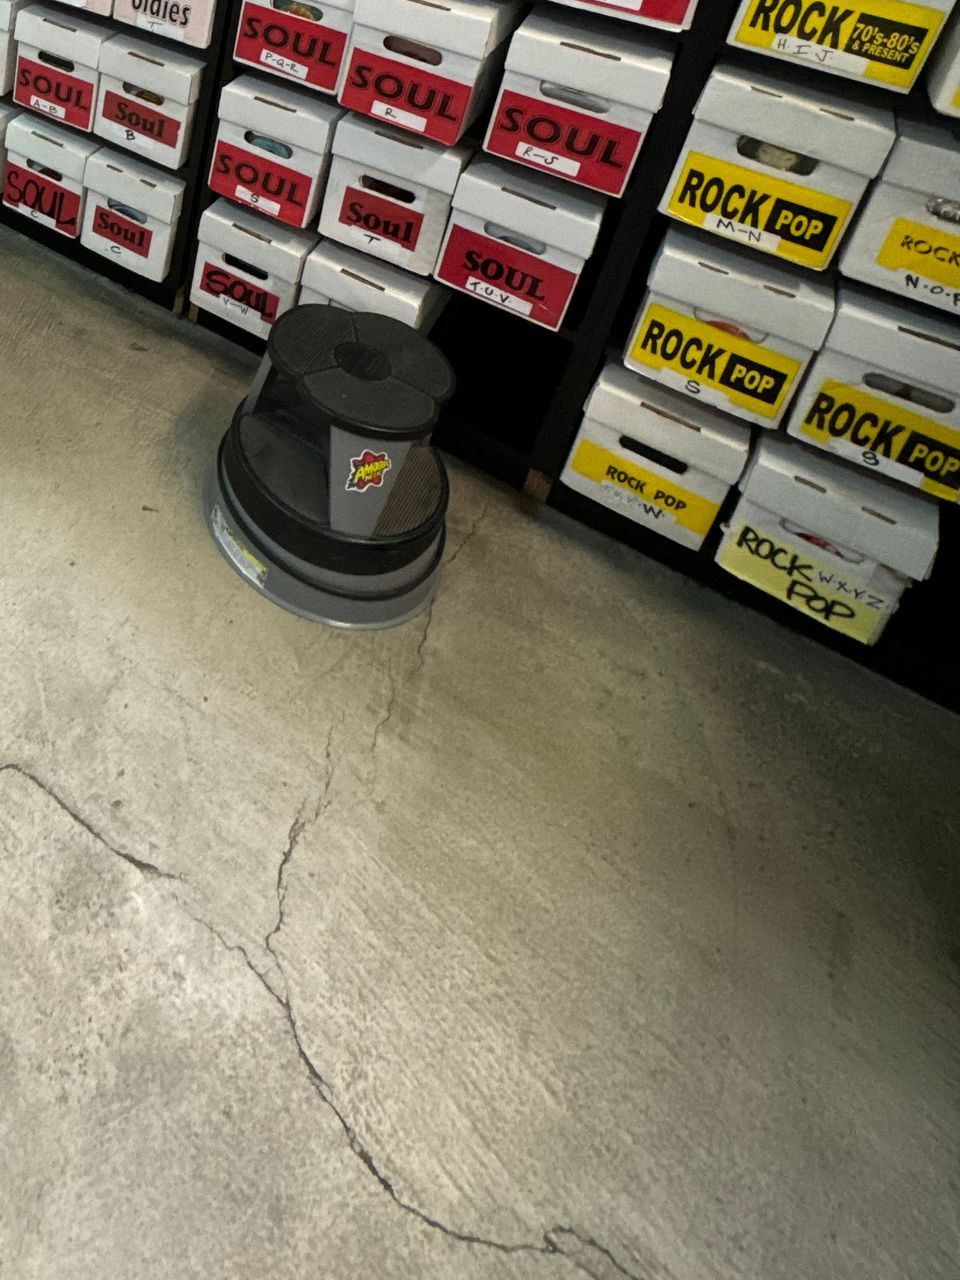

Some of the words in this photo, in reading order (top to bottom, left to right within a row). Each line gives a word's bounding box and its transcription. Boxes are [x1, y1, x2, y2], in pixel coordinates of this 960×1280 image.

[241, 16, 338, 68] SOUL
[851, 23, 920, 54] 70's-80's
[851, 41, 859, 51] &
[861, 43, 910, 63] PRESENT
[33, 99, 58, 114] A-B
[349, 65, 459, 122] SOUL
[116, 103, 166, 138] Soul
[125, 129, 136, 141] B
[677, 168, 773, 230] ROCK
[777, 210, 826, 241] POP
[98, 212, 146, 245] Soul
[346, 201, 415, 244] Soul
[716, 217, 762, 242] M-N
[640, 319, 729, 385] ROCK
[730, 364, 776, 393] POP
